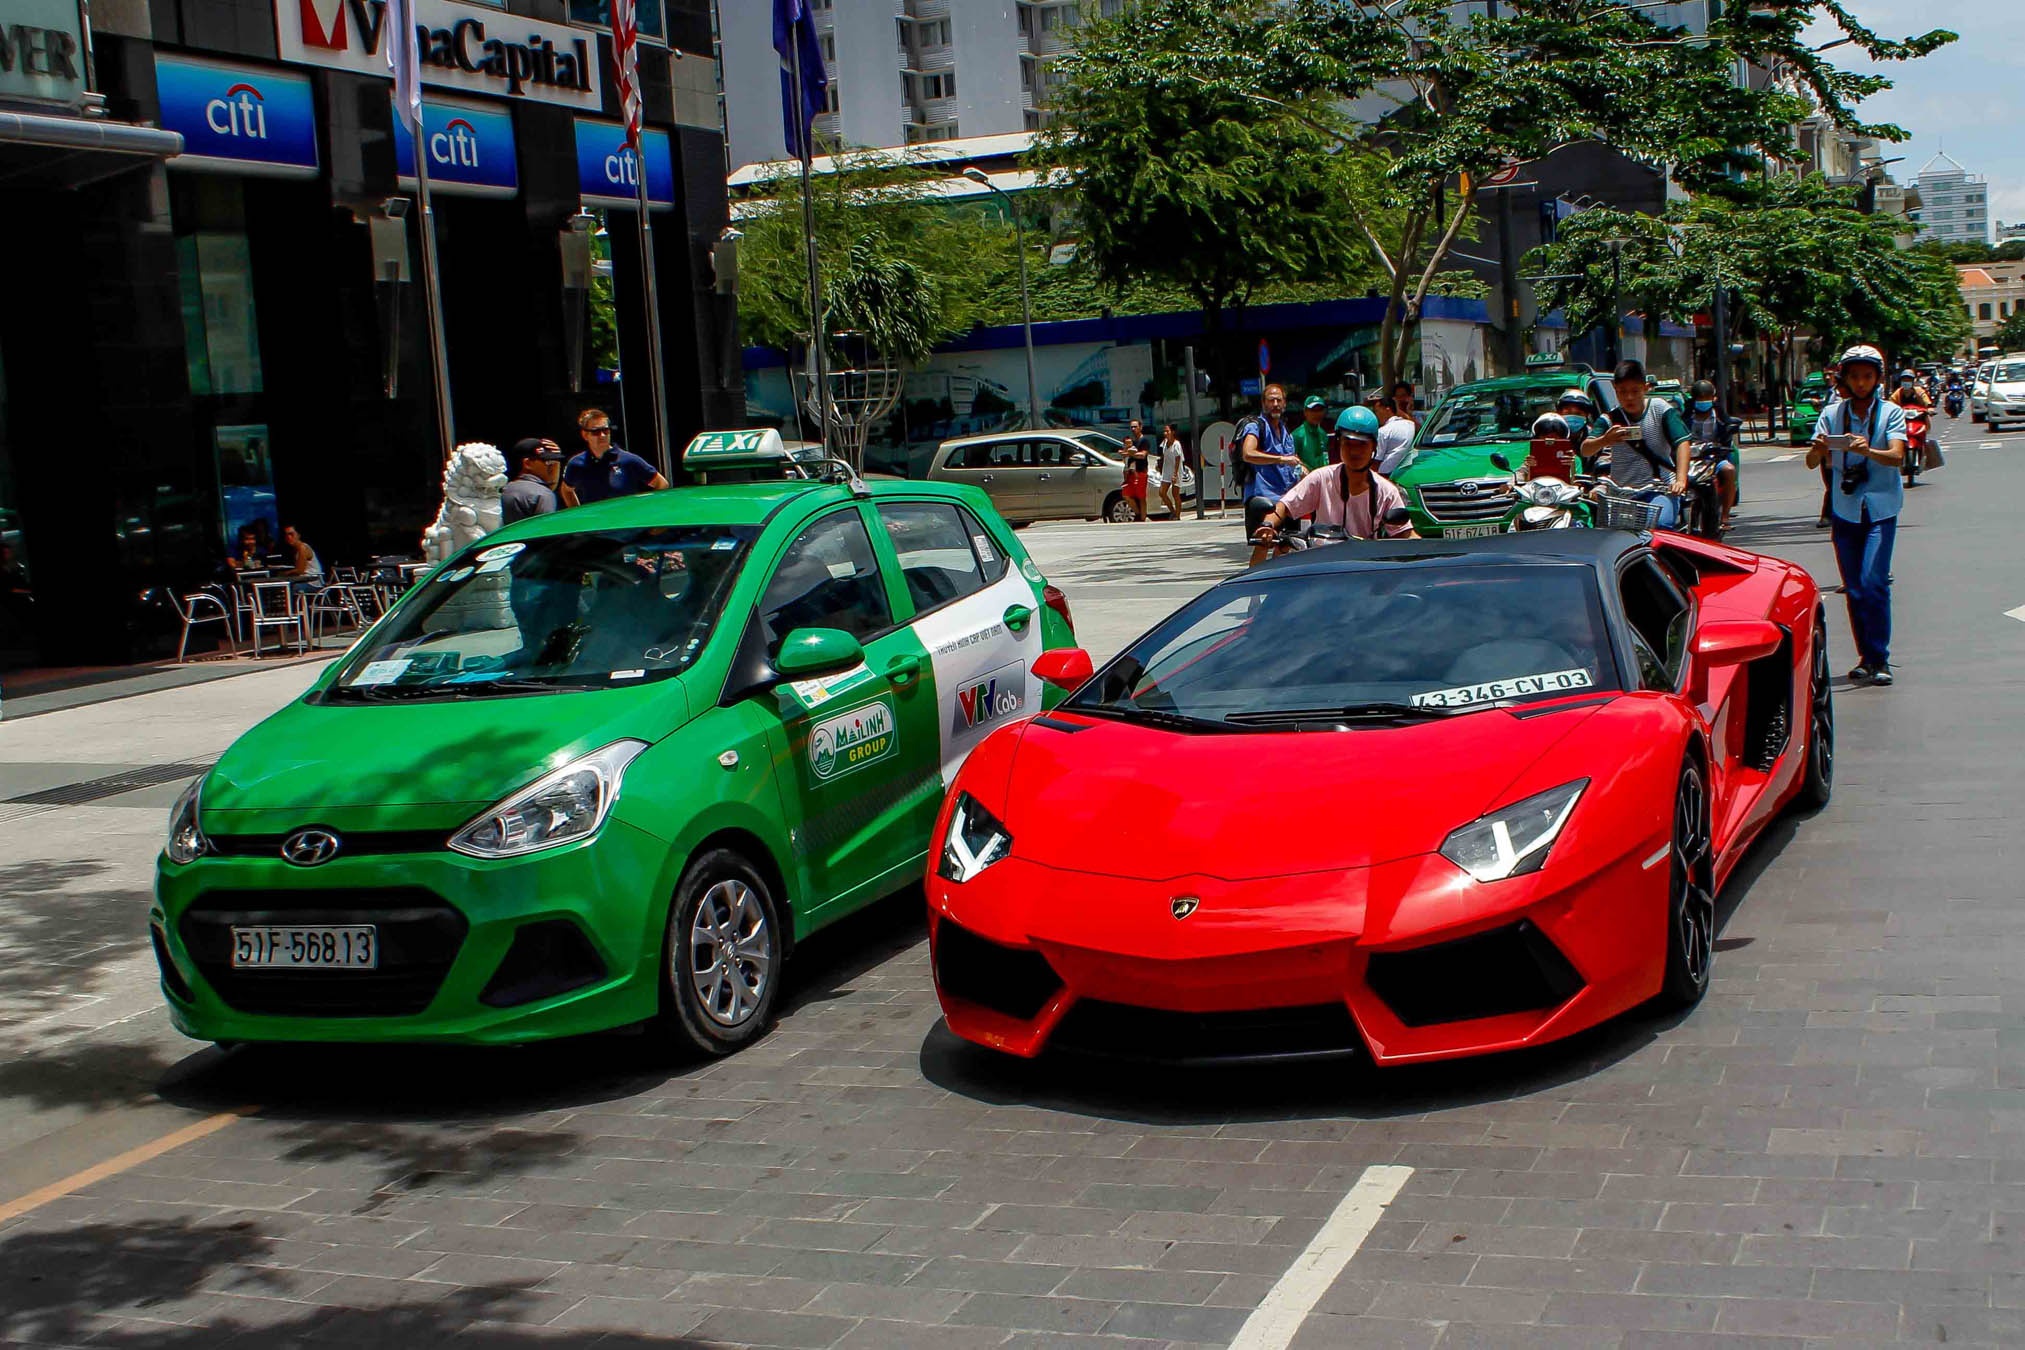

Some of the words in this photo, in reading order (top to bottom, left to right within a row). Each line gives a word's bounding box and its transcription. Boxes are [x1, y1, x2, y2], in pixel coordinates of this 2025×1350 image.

[351, 0, 592, 95] VnaCapital
[206, 84, 266, 139] citi
[431, 118, 479, 167] citi
[849, 737, 887, 762] GROUP
[239, 931, 371, 963] 51F-568.13
